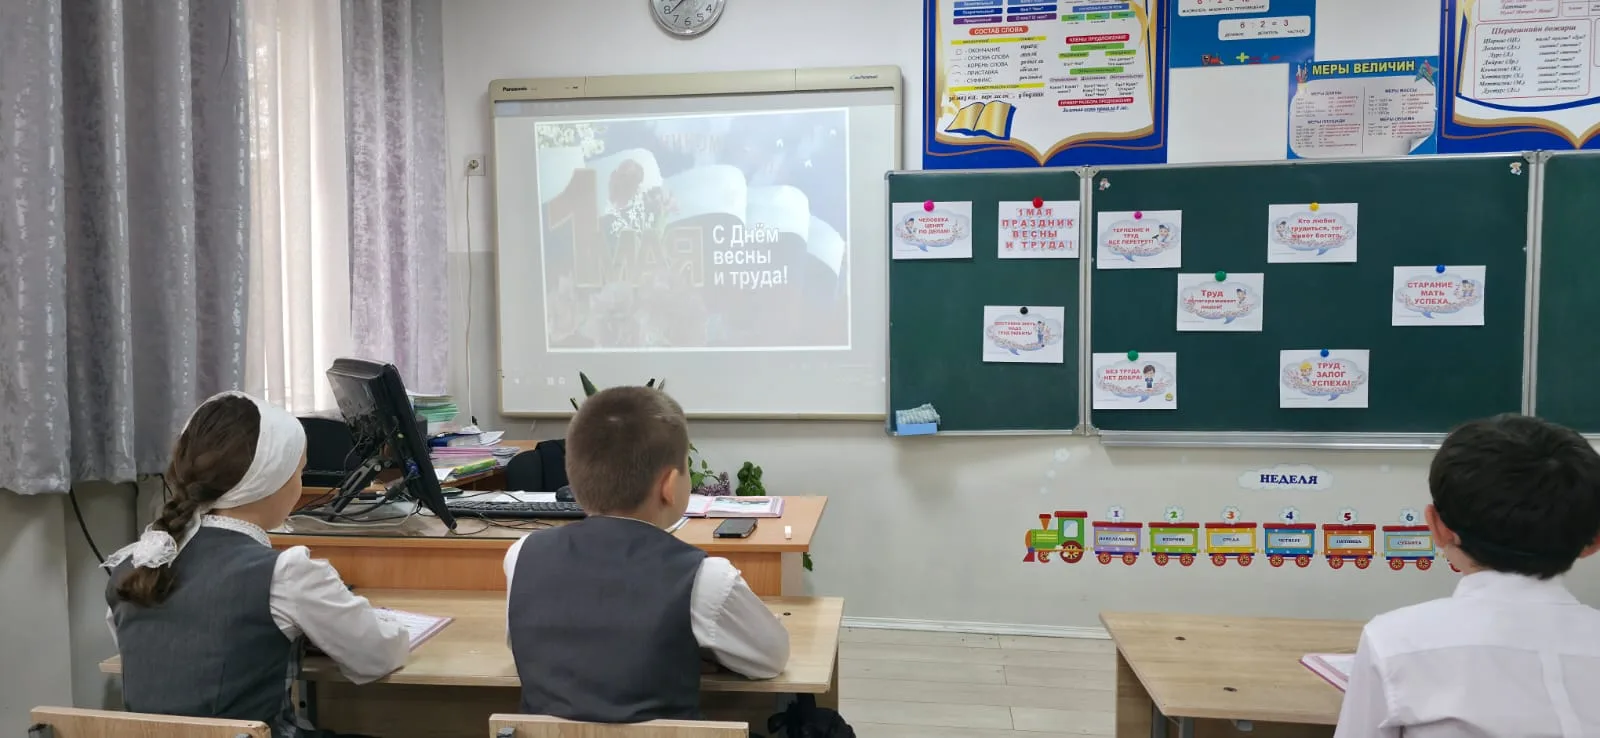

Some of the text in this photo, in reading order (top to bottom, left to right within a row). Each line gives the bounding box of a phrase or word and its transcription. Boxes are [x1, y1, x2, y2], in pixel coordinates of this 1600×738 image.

[664, 5, 671, 14] 8
[673, 15, 679, 23] 7
[684, 17, 692, 26] 6
[697, 13, 704, 22] 5
[1312, 60, 1415, 76] МЕРЫ ВЕЛИЧИН
[1002, 220, 1073, 228] ПРАЗДНИК
[713, 223, 779, 248] С Днём
[1020, 241, 1073, 250] ТРУДА!
[714, 250, 772, 264] весны
[714, 264, 788, 290] и труда!
[1201, 290, 1224, 298] Труд
[1260, 474, 1318, 484] НЕДЕЛЯ
[1113, 510, 1120, 518] 1
[1227, 511, 1234, 519] 3
[1286, 512, 1294, 520] 4
[1344, 512, 1351, 521] 5
[1406, 513, 1414, 522] 6
